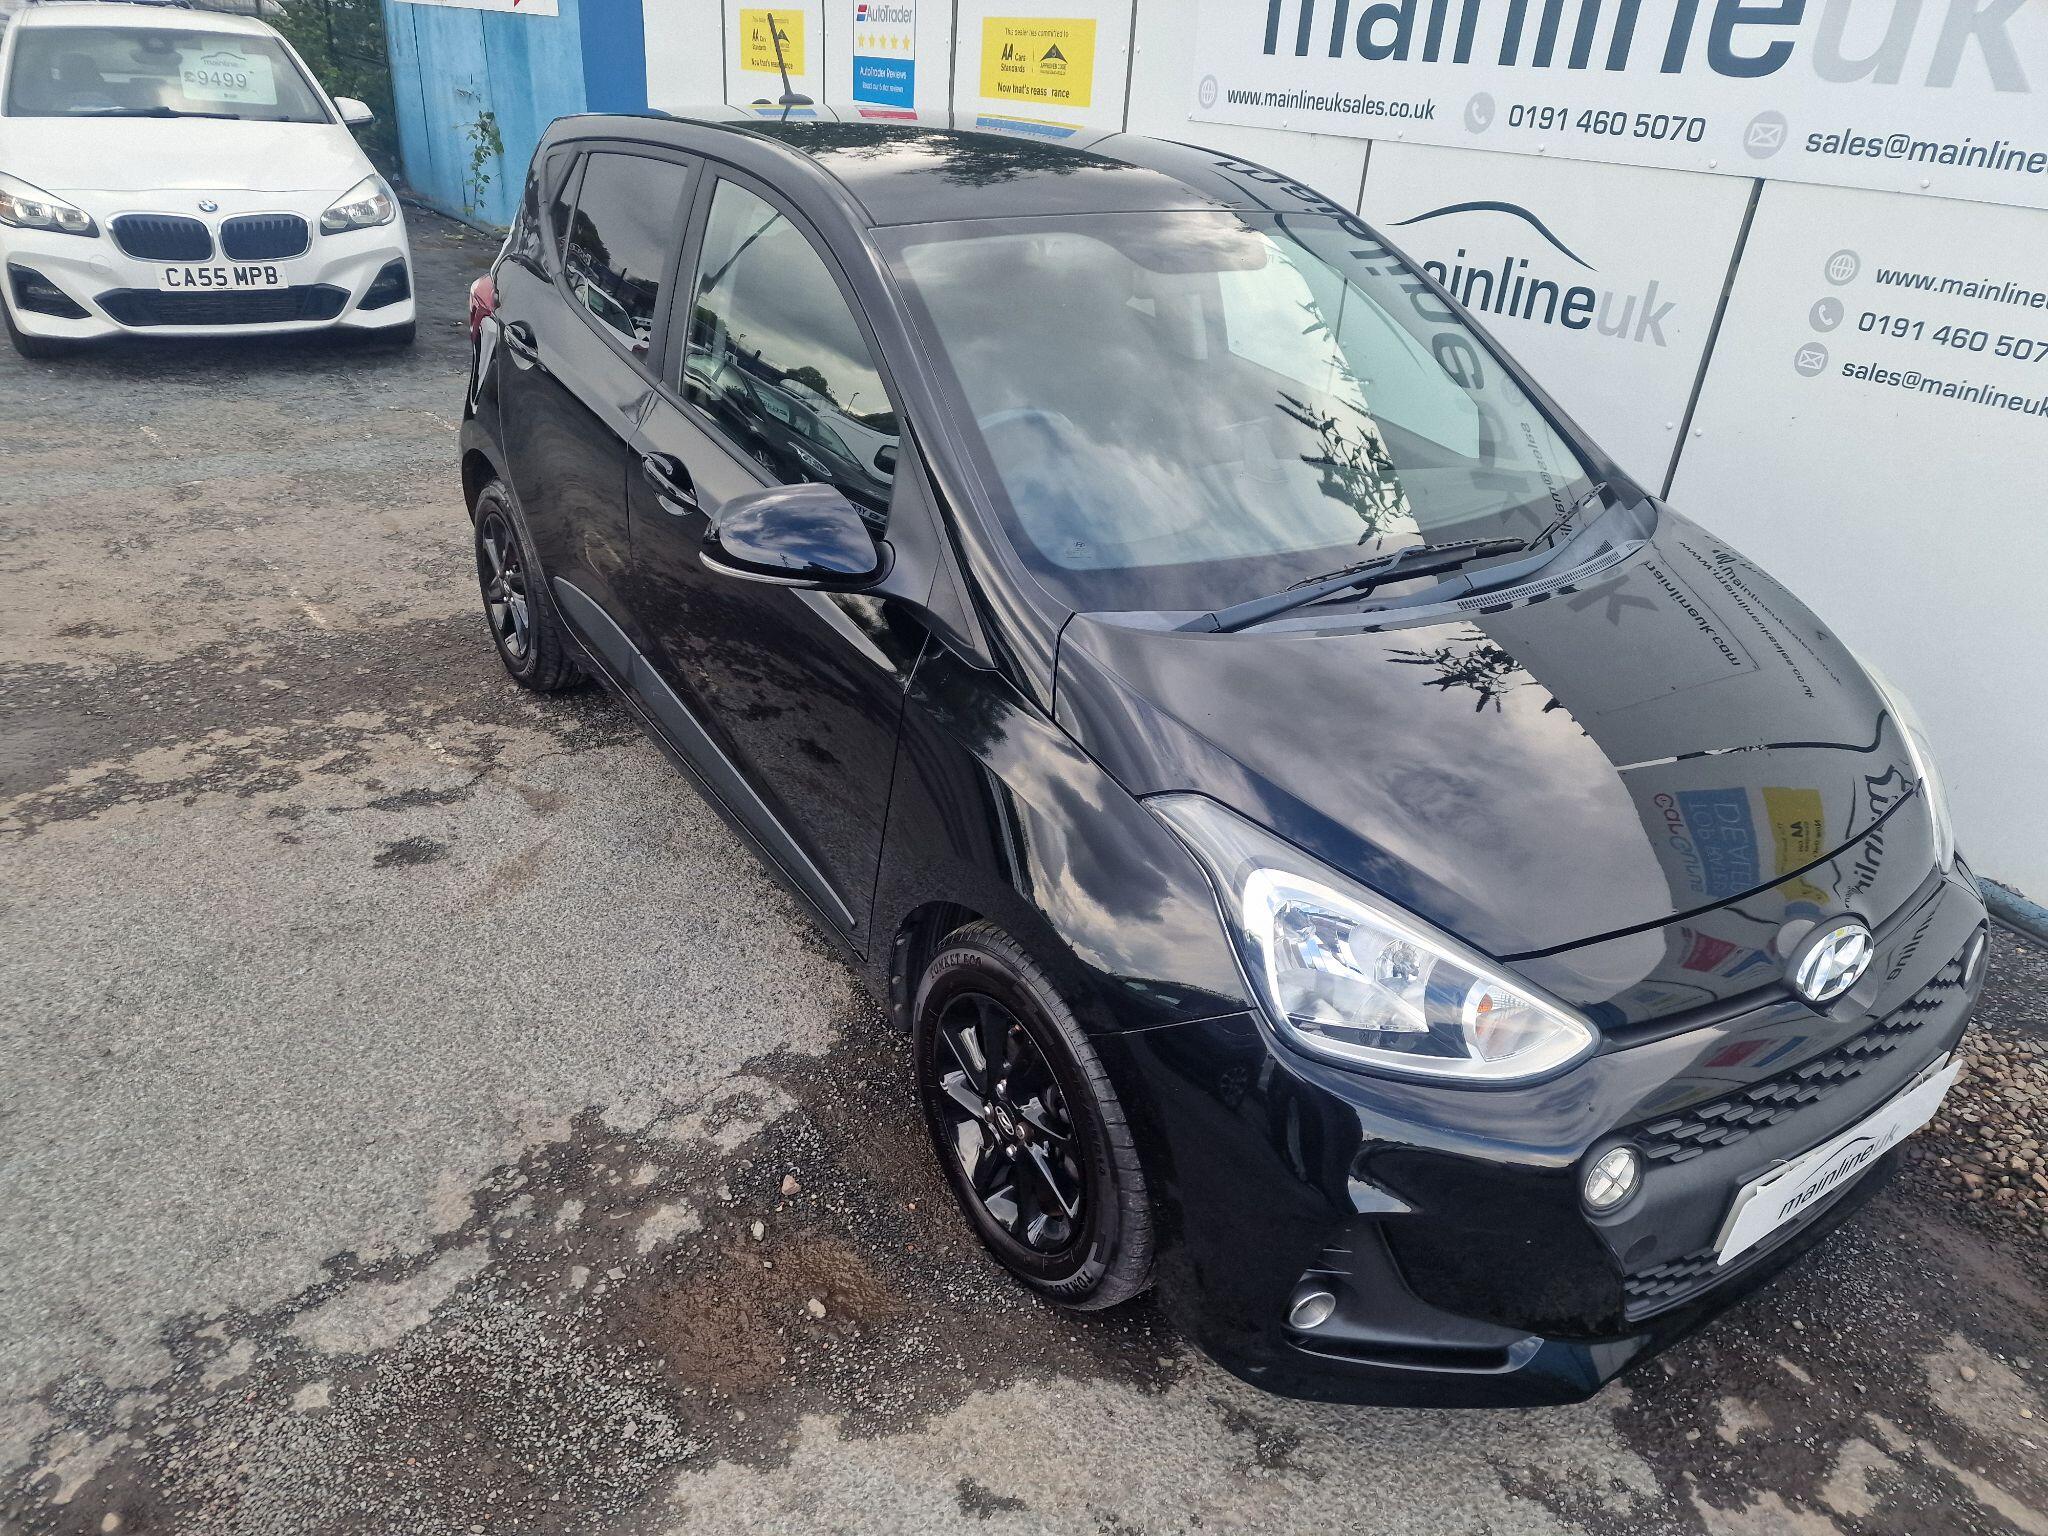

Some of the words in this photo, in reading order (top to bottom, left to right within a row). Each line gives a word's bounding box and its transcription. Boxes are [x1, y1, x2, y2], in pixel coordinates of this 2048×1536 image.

[867, 5, 912, 23] AutoTrader
[1001, 43, 1014, 61] AA
[1014, 52, 1026, 62] Cars
[860, 66, 885, 78] AutoTrader
[886, 67, 906, 79] Reviews
[1000, 63, 1025, 73] Standards
[997, 82, 1012, 94] Now
[1012, 83, 1030, 96] that's
[1227, 88, 1436, 120] www.mainlineuksales.co.uk
[1508, 104, 1568, 131] 0191
[1576, 109, 1627, 136] 460
[1633, 113, 1706, 143] 5070
[1805, 128, 2048, 174] sales@mainline
[165, 267, 228, 287] CA55
[233, 266, 278, 286] MPB
[1876, 267, 2048, 310] www.mainline
[1858, 311, 1925, 341] 0191
[1932, 325, 1989, 352] 460
[1778, 1123, 1899, 1220] mainlineuk
